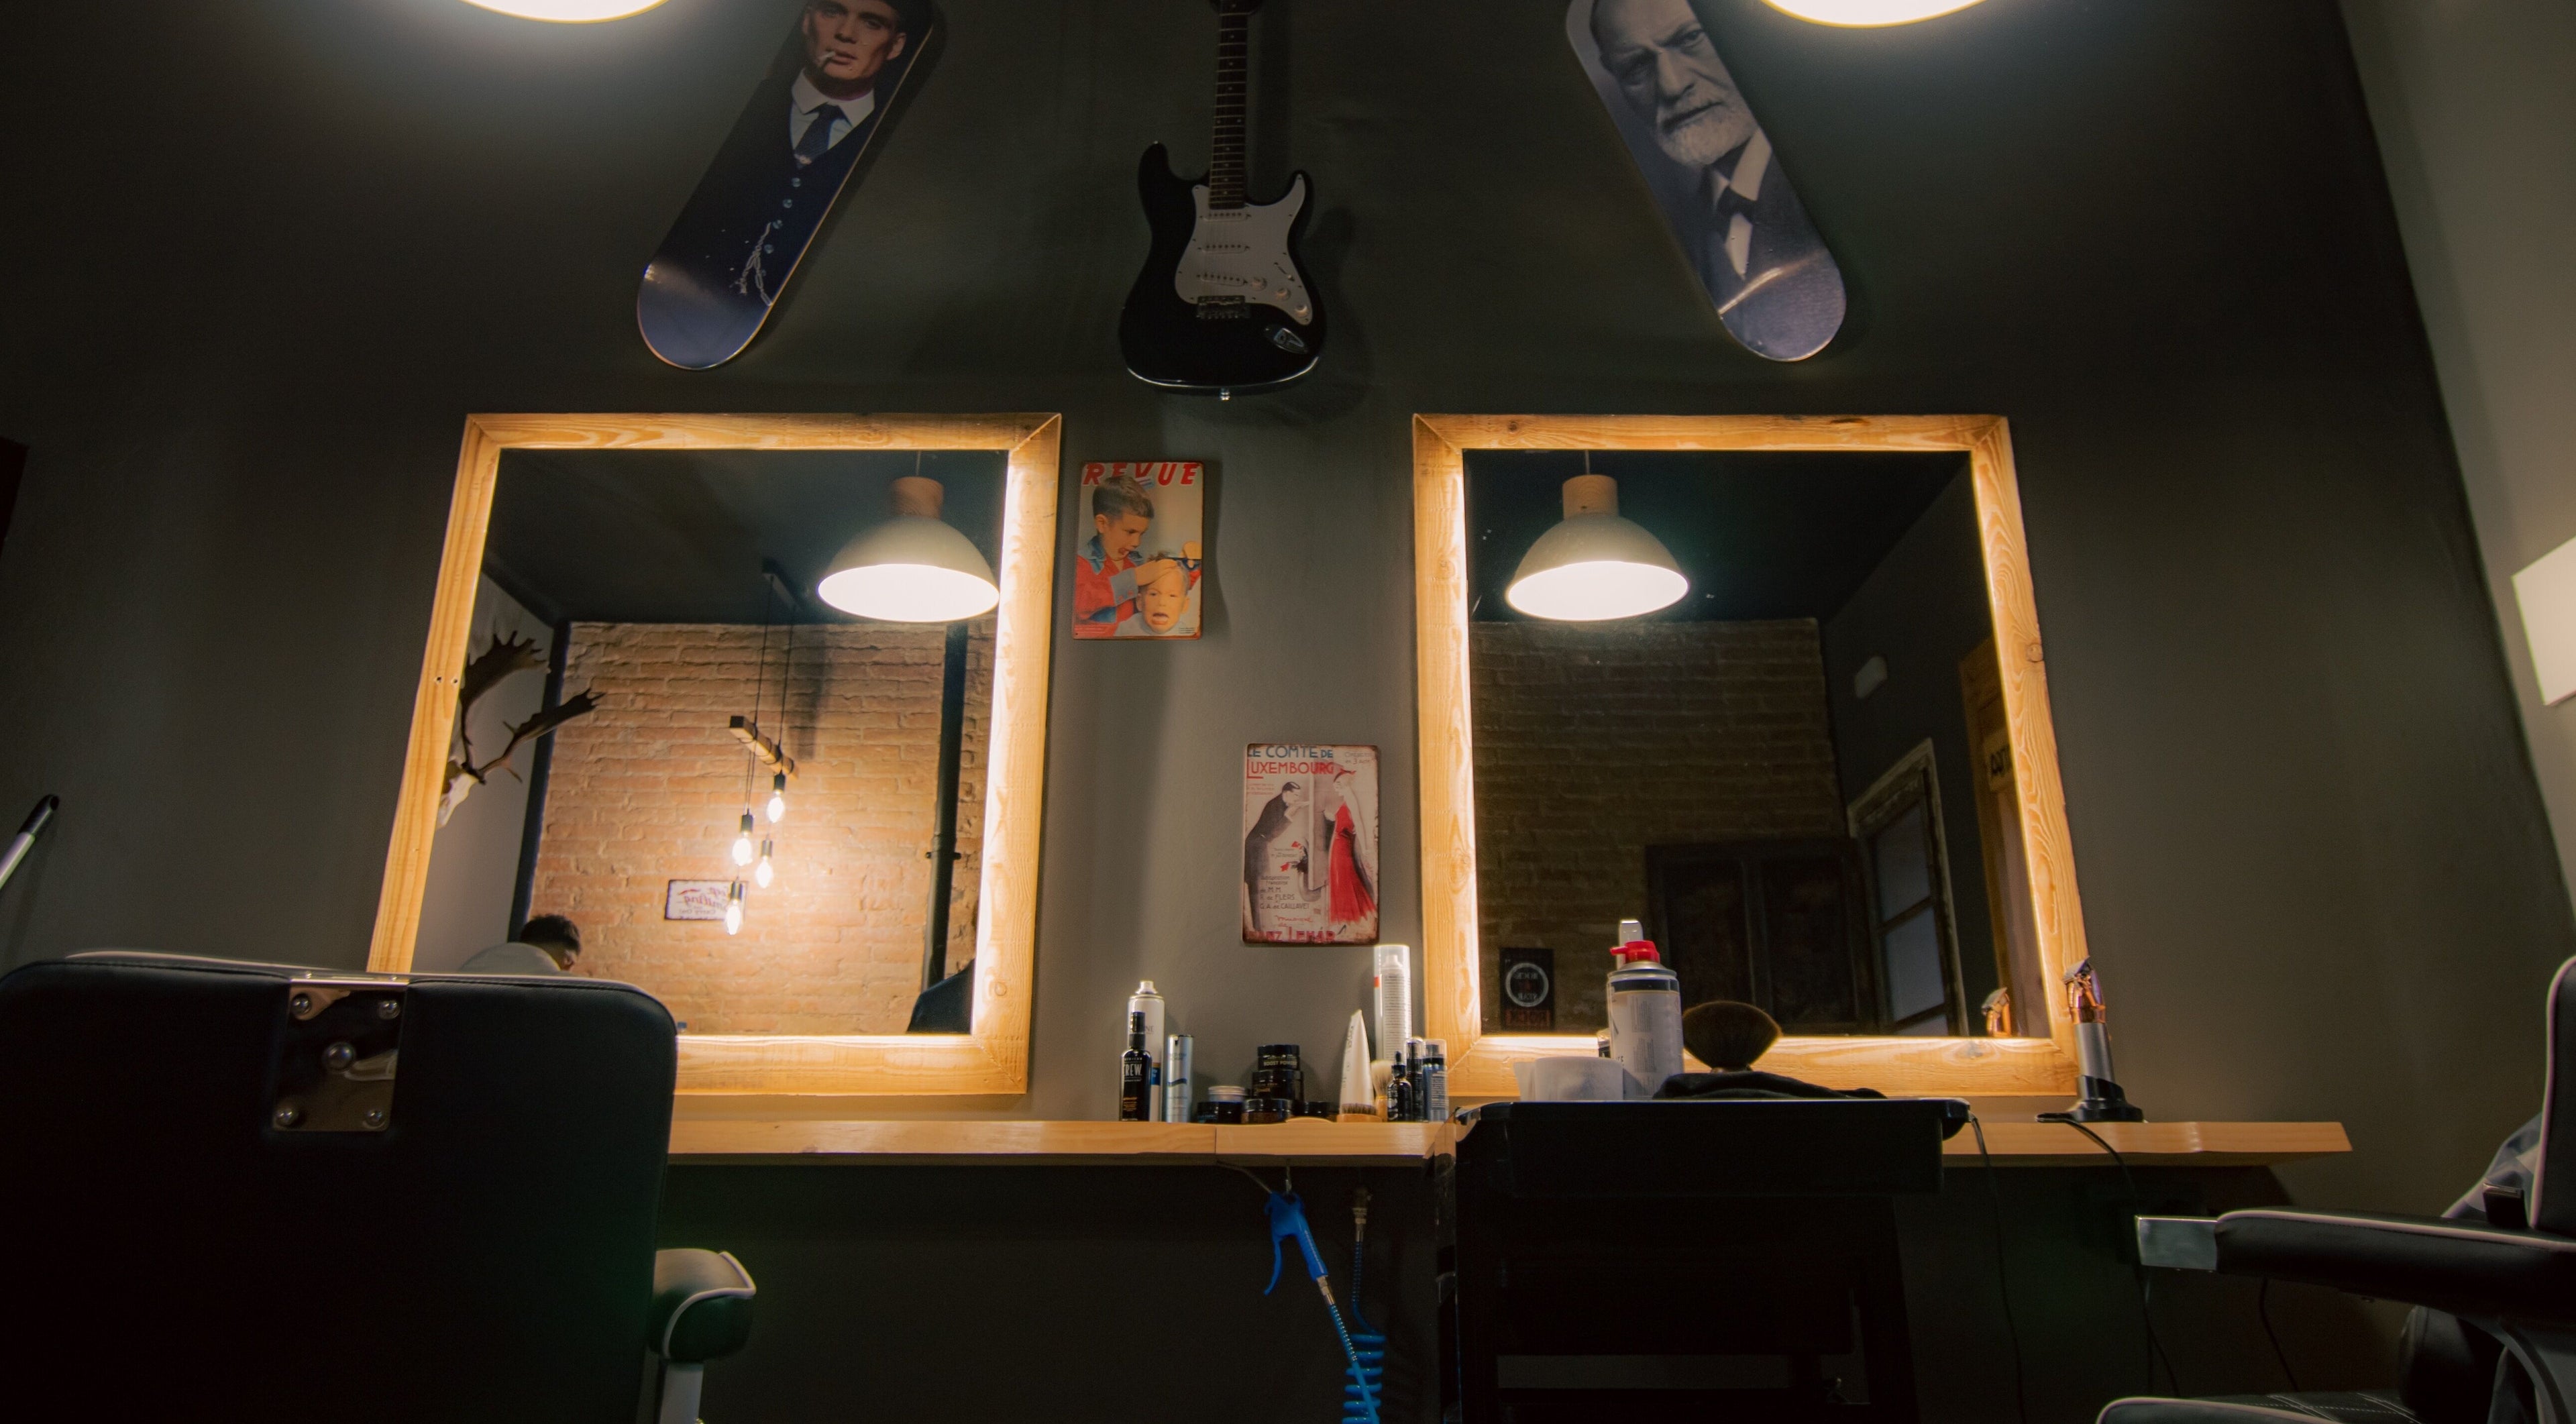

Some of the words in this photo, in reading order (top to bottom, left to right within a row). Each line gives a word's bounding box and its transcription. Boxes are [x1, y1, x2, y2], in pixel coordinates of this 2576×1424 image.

[1082, 462, 1200, 486] REVUE
[1266, 745, 1318, 759] COMTE
[1321, 749, 1334, 759] DE
[1246, 759, 1335, 779] LUXEMBOURG
[1124, 1063, 1142, 1077] REW
